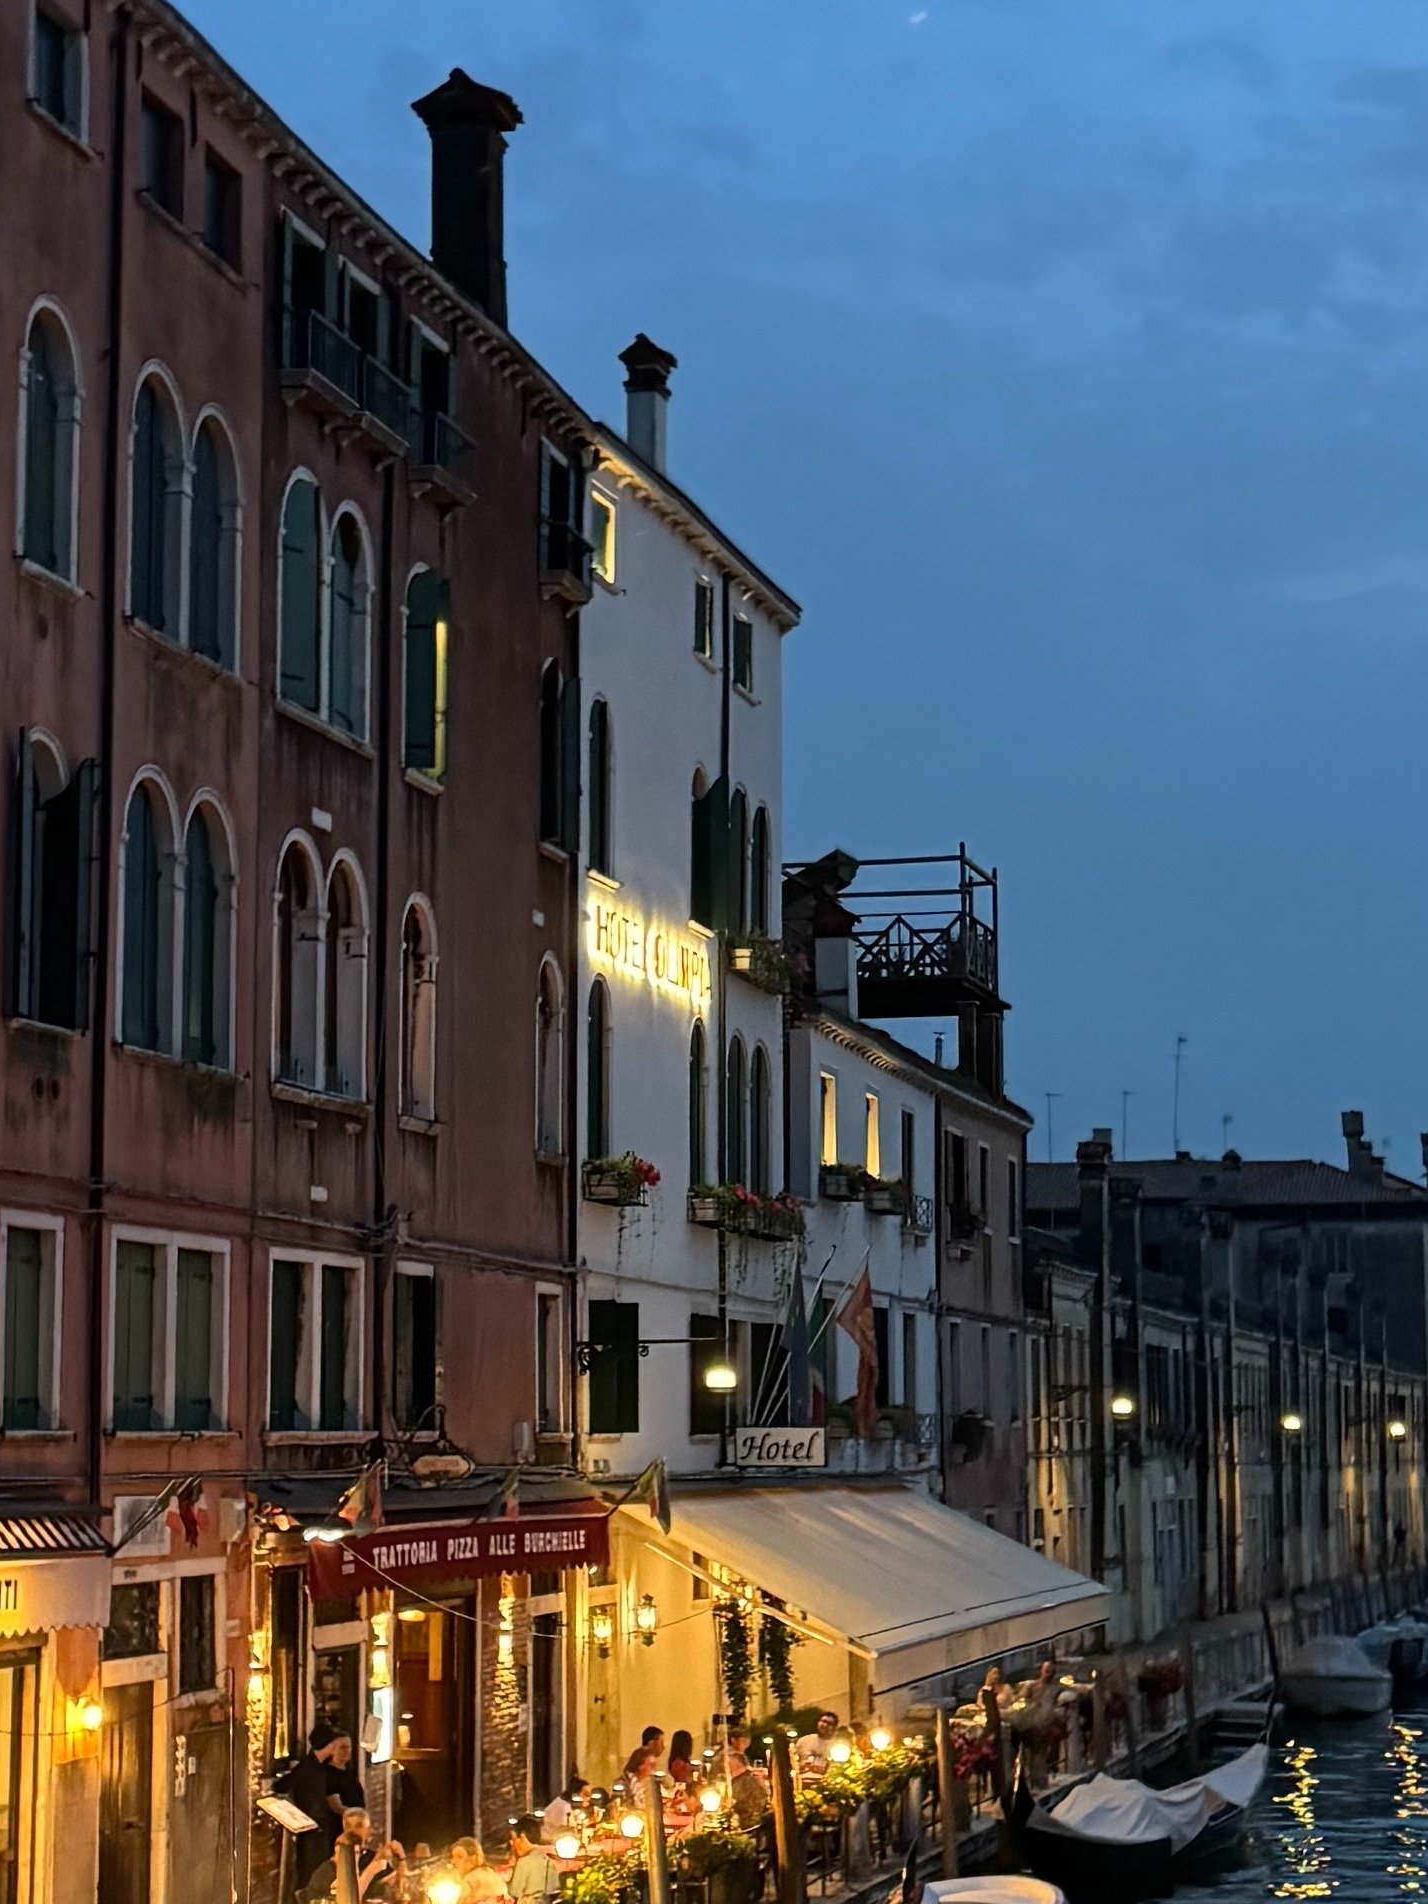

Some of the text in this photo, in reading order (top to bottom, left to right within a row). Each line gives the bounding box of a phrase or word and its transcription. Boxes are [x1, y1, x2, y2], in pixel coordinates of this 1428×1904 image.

[596, 905, 648, 972] HOTEL
[739, 1430, 820, 1461] Hotel
[372, 1539, 439, 1571] TRATTORIA
[446, 1536, 479, 1561] PIZZA
[488, 1533, 516, 1556] ALLE
